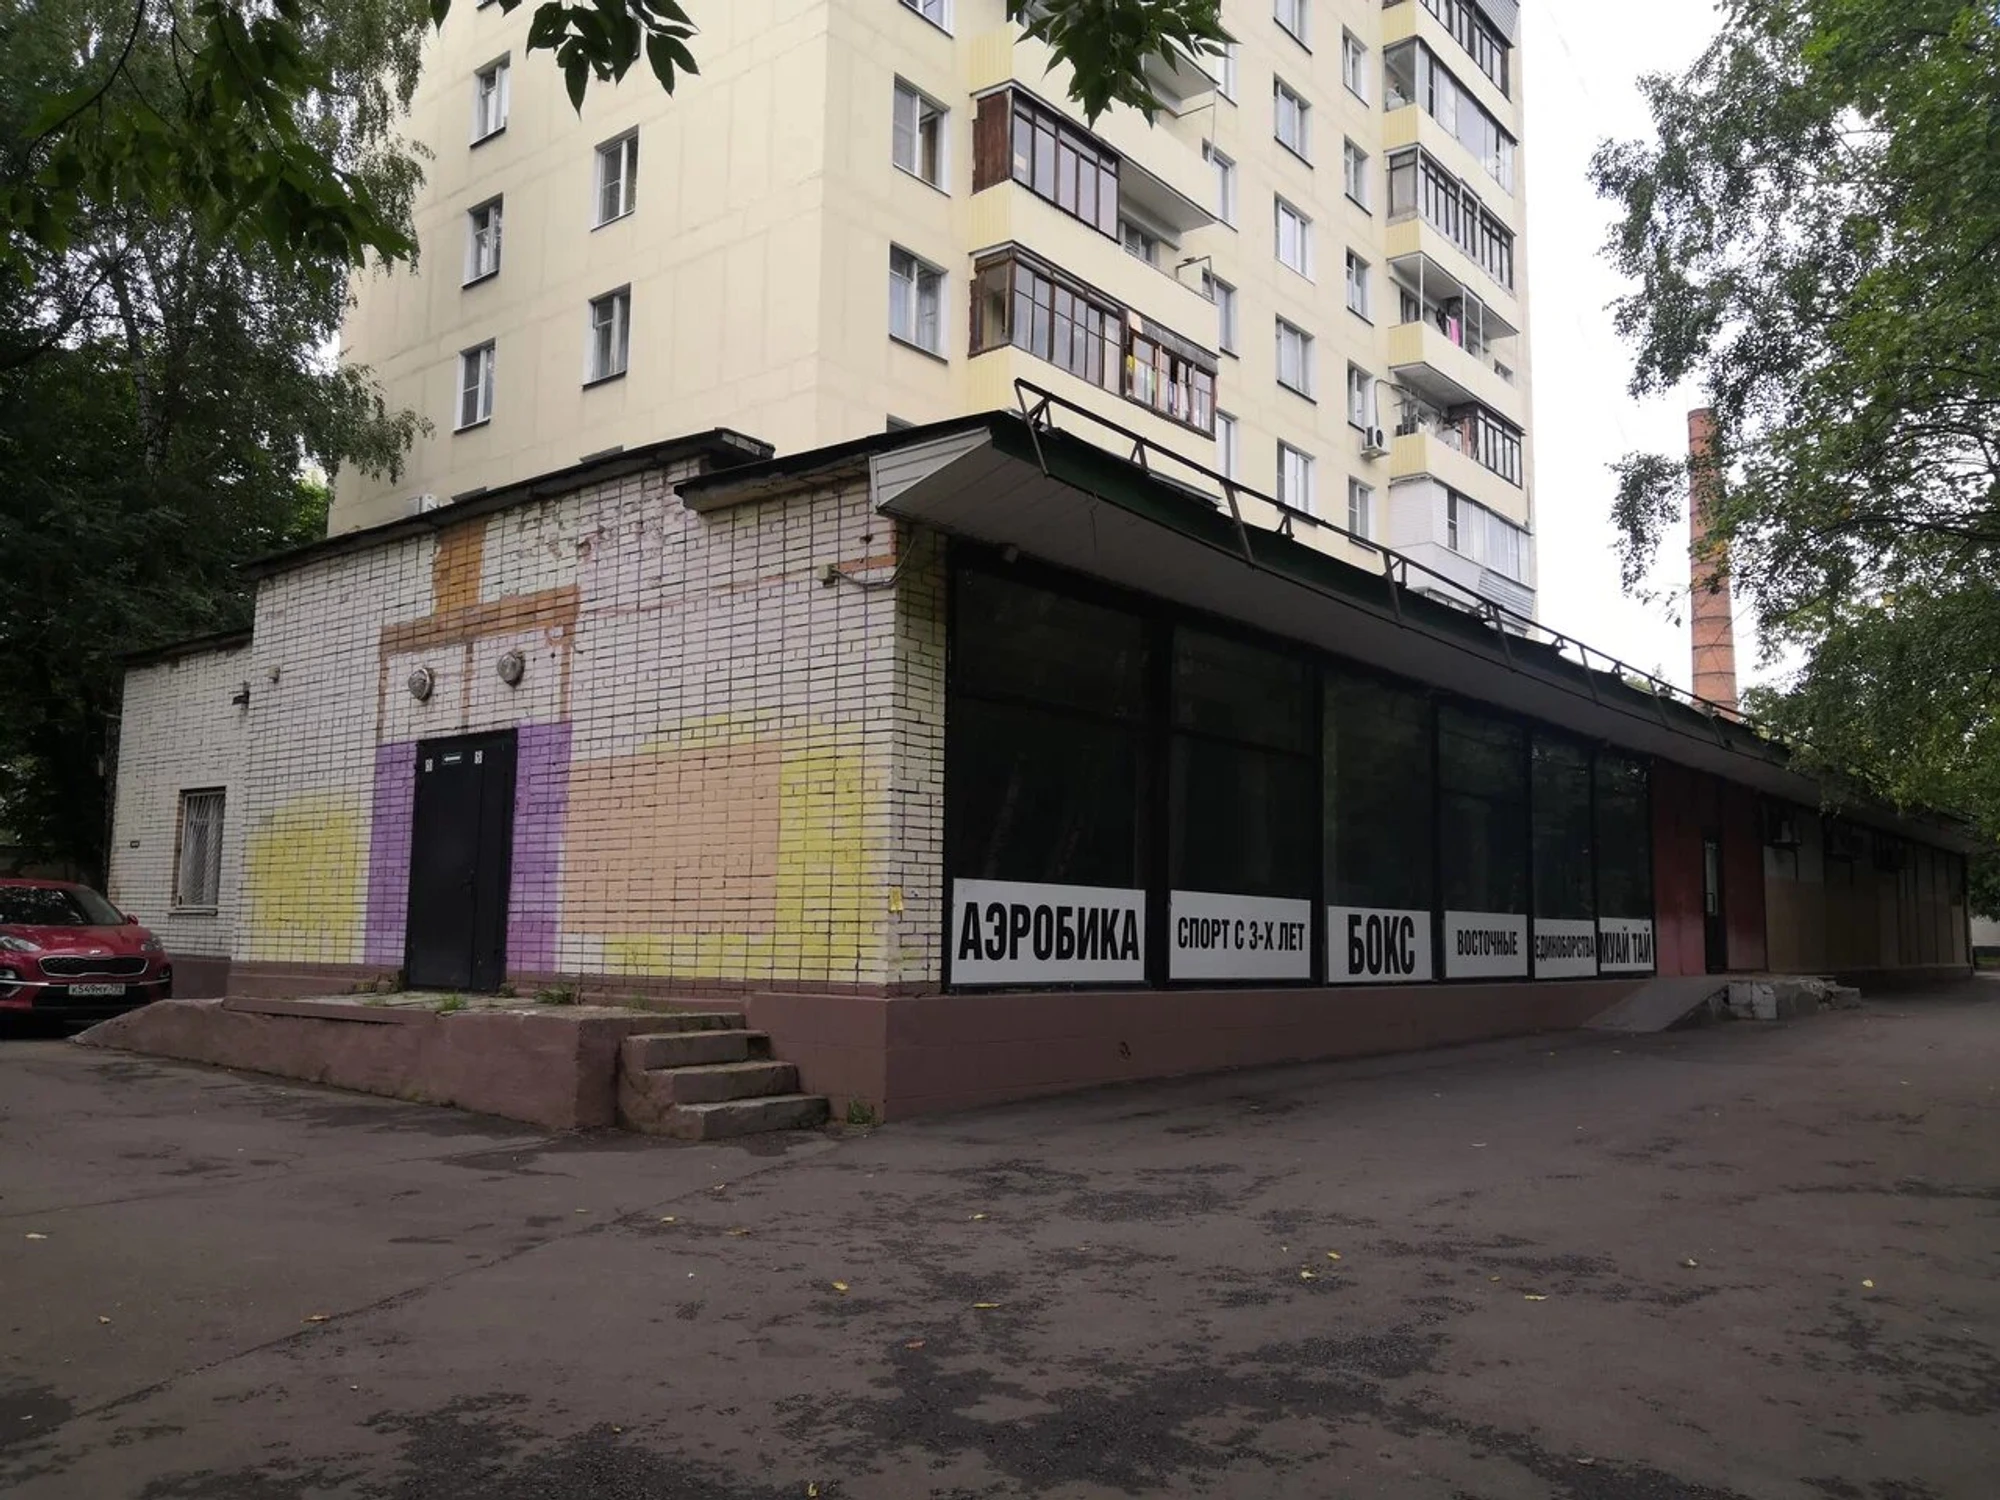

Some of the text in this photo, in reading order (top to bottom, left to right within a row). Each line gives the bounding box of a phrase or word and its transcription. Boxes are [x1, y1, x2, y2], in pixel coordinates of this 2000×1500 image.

[958, 902, 1140, 961] АЭРОБИКА
[1178, 917, 1305, 951] СПОРТ С 3-Х ЛЕТ
[1348, 914, 1415, 975] БОКС
[1457, 930, 1518, 956] ВОСТОЧНЫЕ
[1535, 935, 1596, 961] ЕДИНОБОРСТВА
[1632, 927, 1652, 963] ТАЙ
